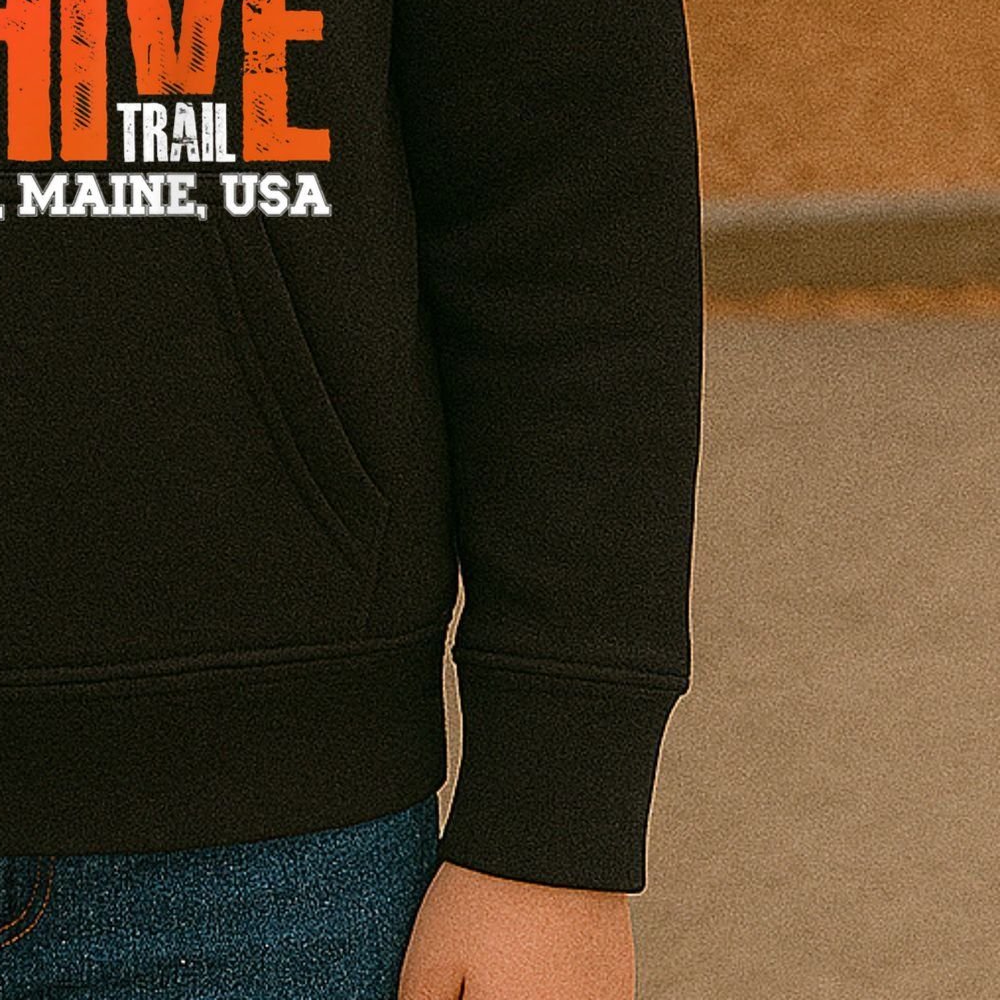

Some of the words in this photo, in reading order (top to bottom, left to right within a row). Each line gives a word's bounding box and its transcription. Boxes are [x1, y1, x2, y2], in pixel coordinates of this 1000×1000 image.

[116, 102, 236, 163] TRAIL
[17, 173, 208, 222] MAINE,
[219, 173, 332, 219] USA
